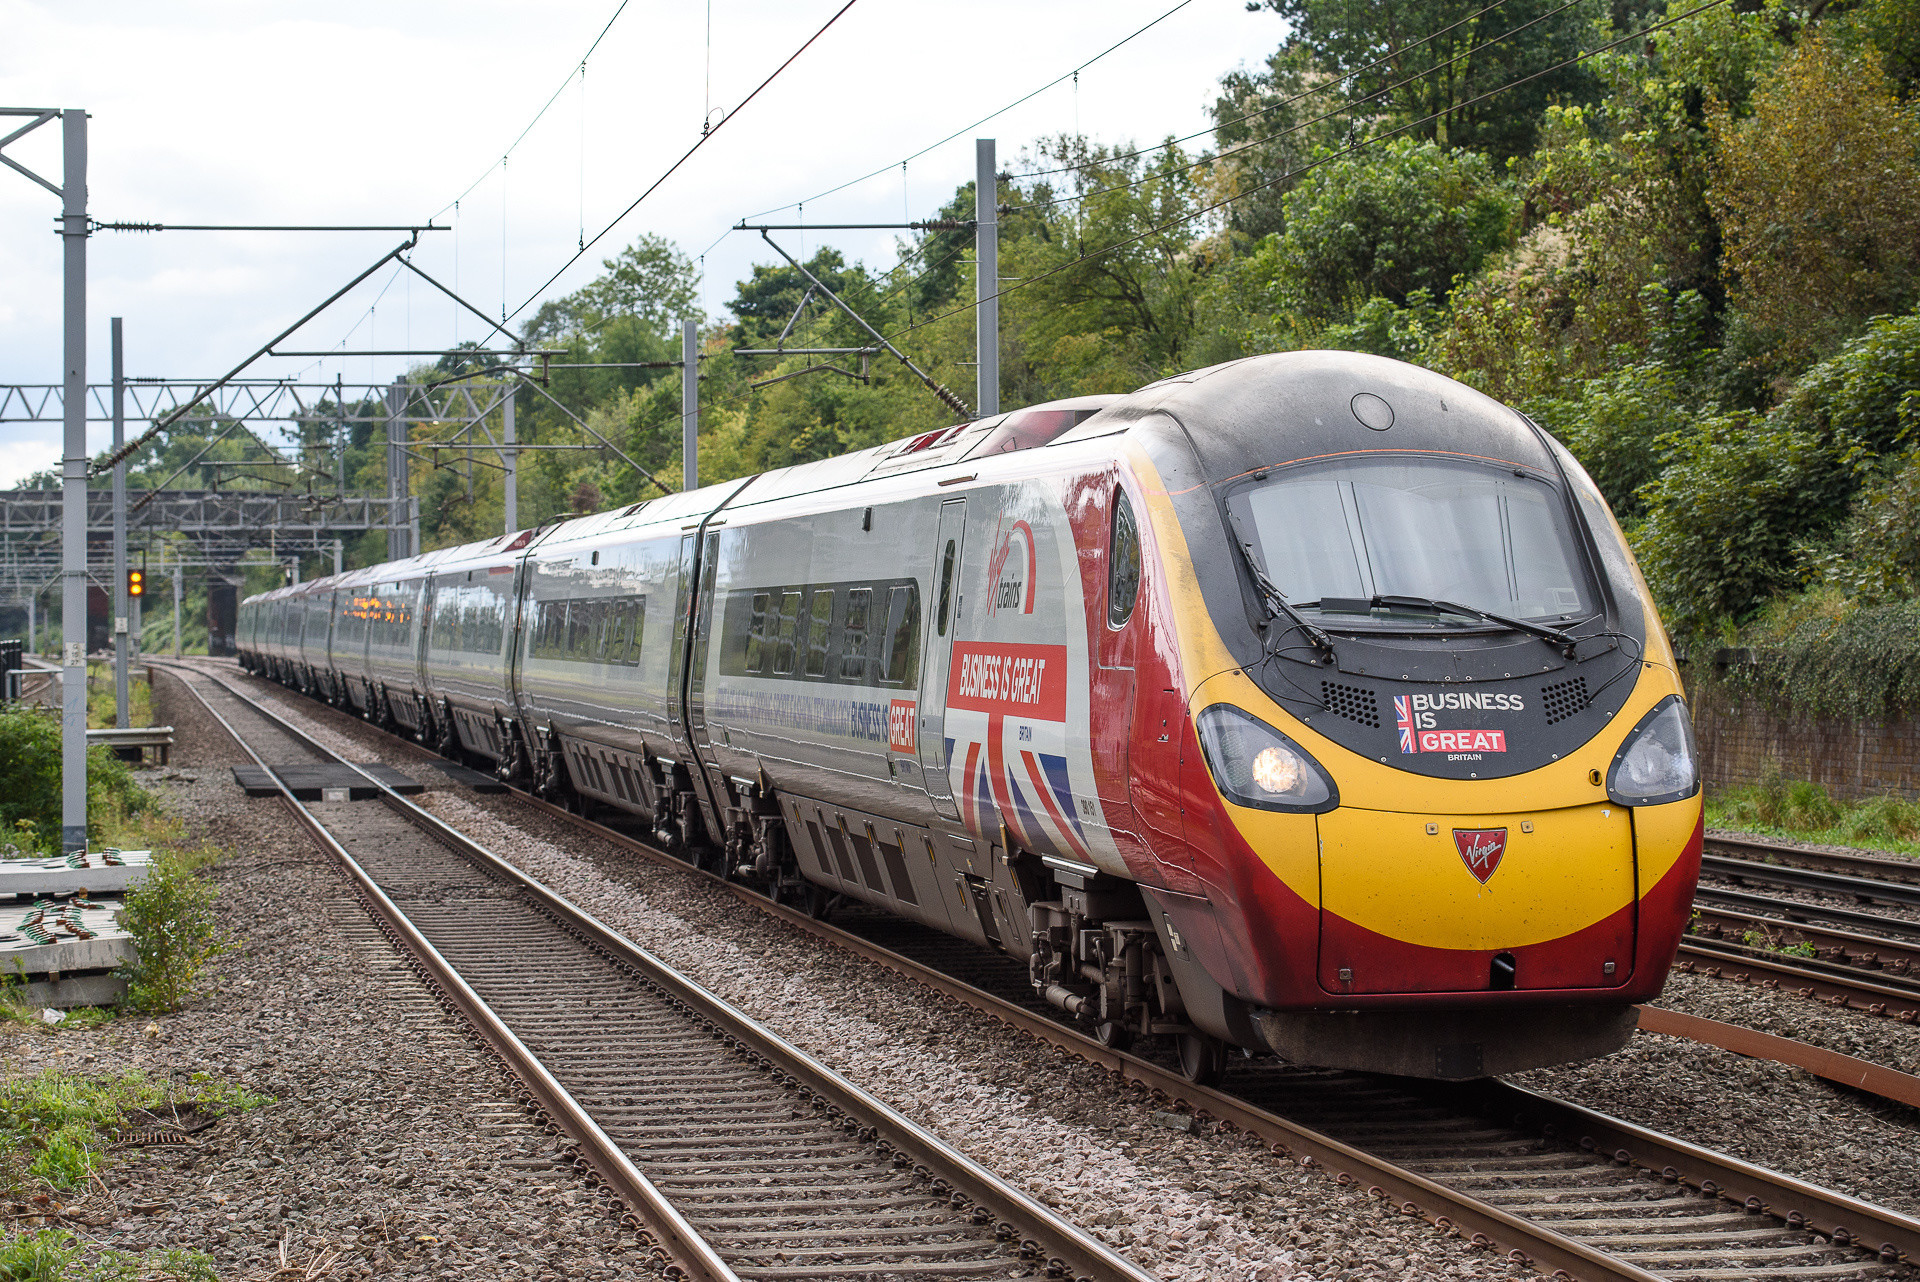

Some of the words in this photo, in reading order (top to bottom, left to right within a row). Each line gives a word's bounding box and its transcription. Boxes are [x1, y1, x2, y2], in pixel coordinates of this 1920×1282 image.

[987, 509, 1010, 618] Virgin
[997, 573, 1022, 609] trains
[959, 653, 1001, 700] BUSINESS
[1000, 656, 1012, 702] IS
[1011, 657, 1046, 705] GREAT
[1411, 692, 1525, 711] BUSINESS
[851, 700, 881, 743] BUSINESS
[881, 703, 889, 744] IS
[890, 705, 915, 748] GREAT
[1414, 711, 1437, 729] IS
[1422, 732, 1502, 750] GREAT
[1447, 753, 1482, 761] BRITAIN
[1465, 833, 1502, 869] Virgin
